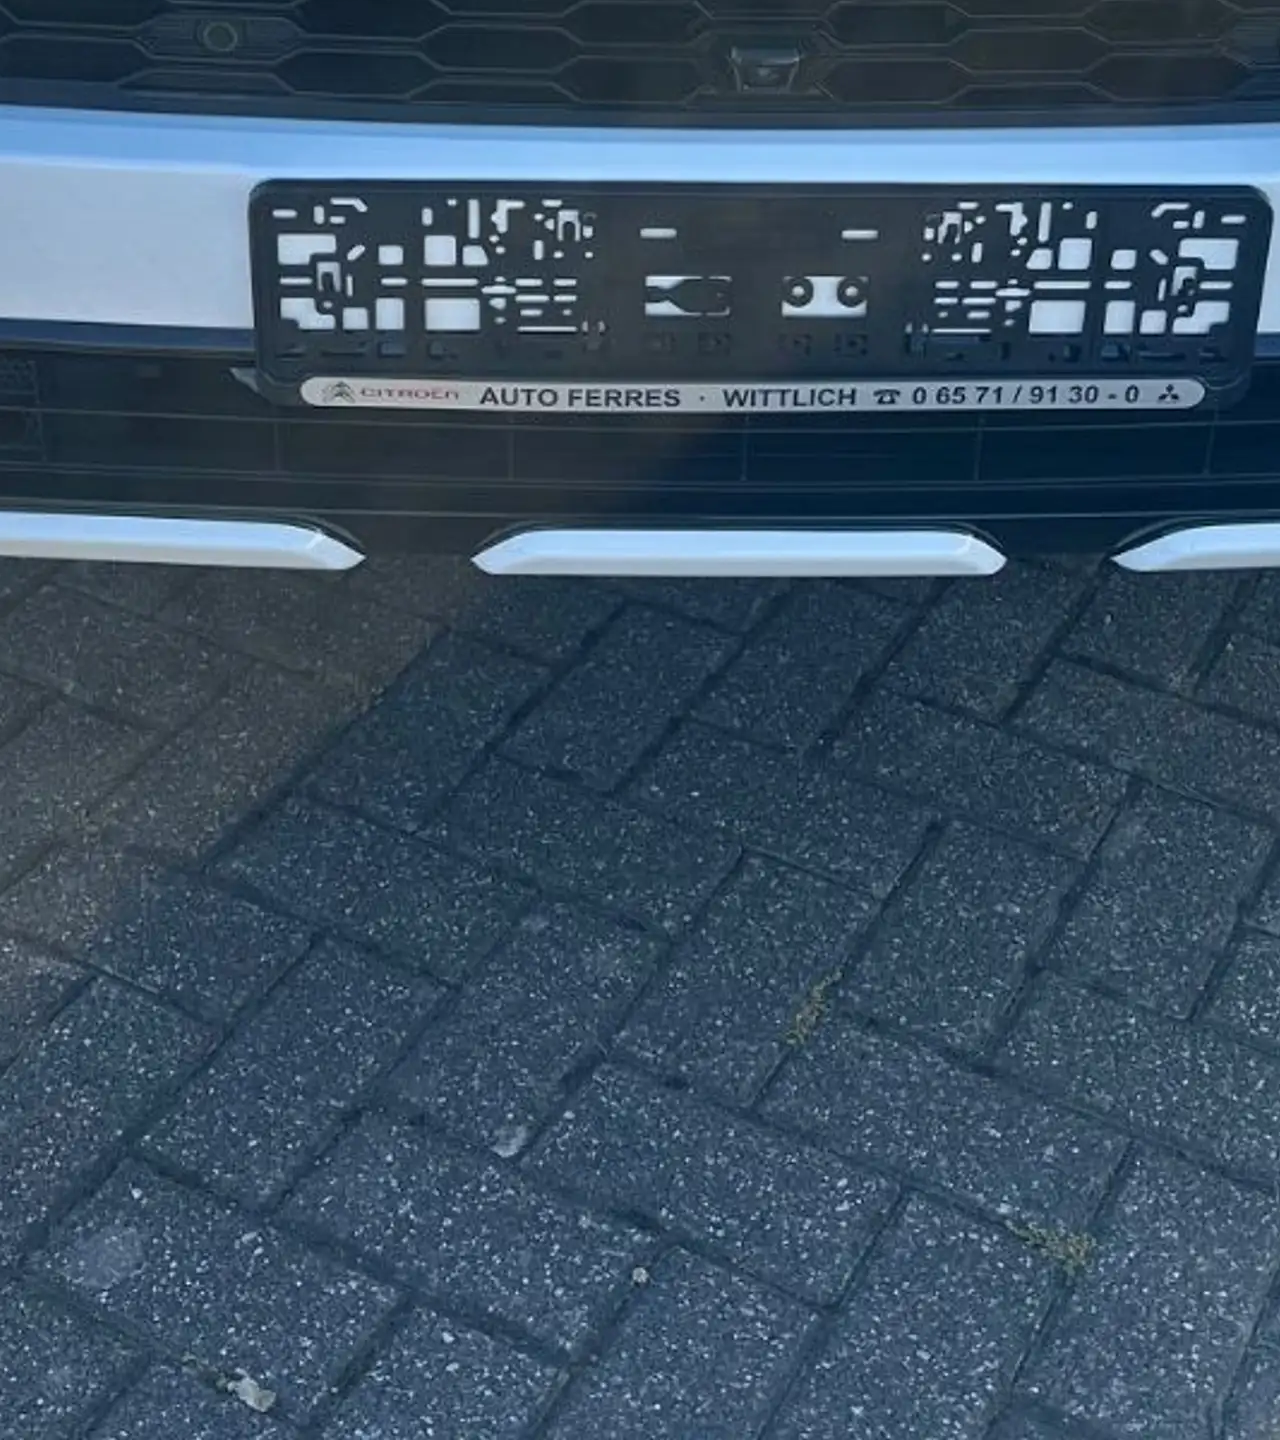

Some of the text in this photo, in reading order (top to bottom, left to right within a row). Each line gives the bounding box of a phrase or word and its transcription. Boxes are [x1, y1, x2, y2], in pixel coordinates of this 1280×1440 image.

[479, 386, 559, 407] AUTO
[567, 388, 681, 408] FERRES
[722, 388, 857, 408] WITTLICH
[935, 386, 967, 405] 65
[975, 385, 1004, 405] 71
[1029, 385, 1058, 405] 91
[1067, 384, 1100, 405] 30
